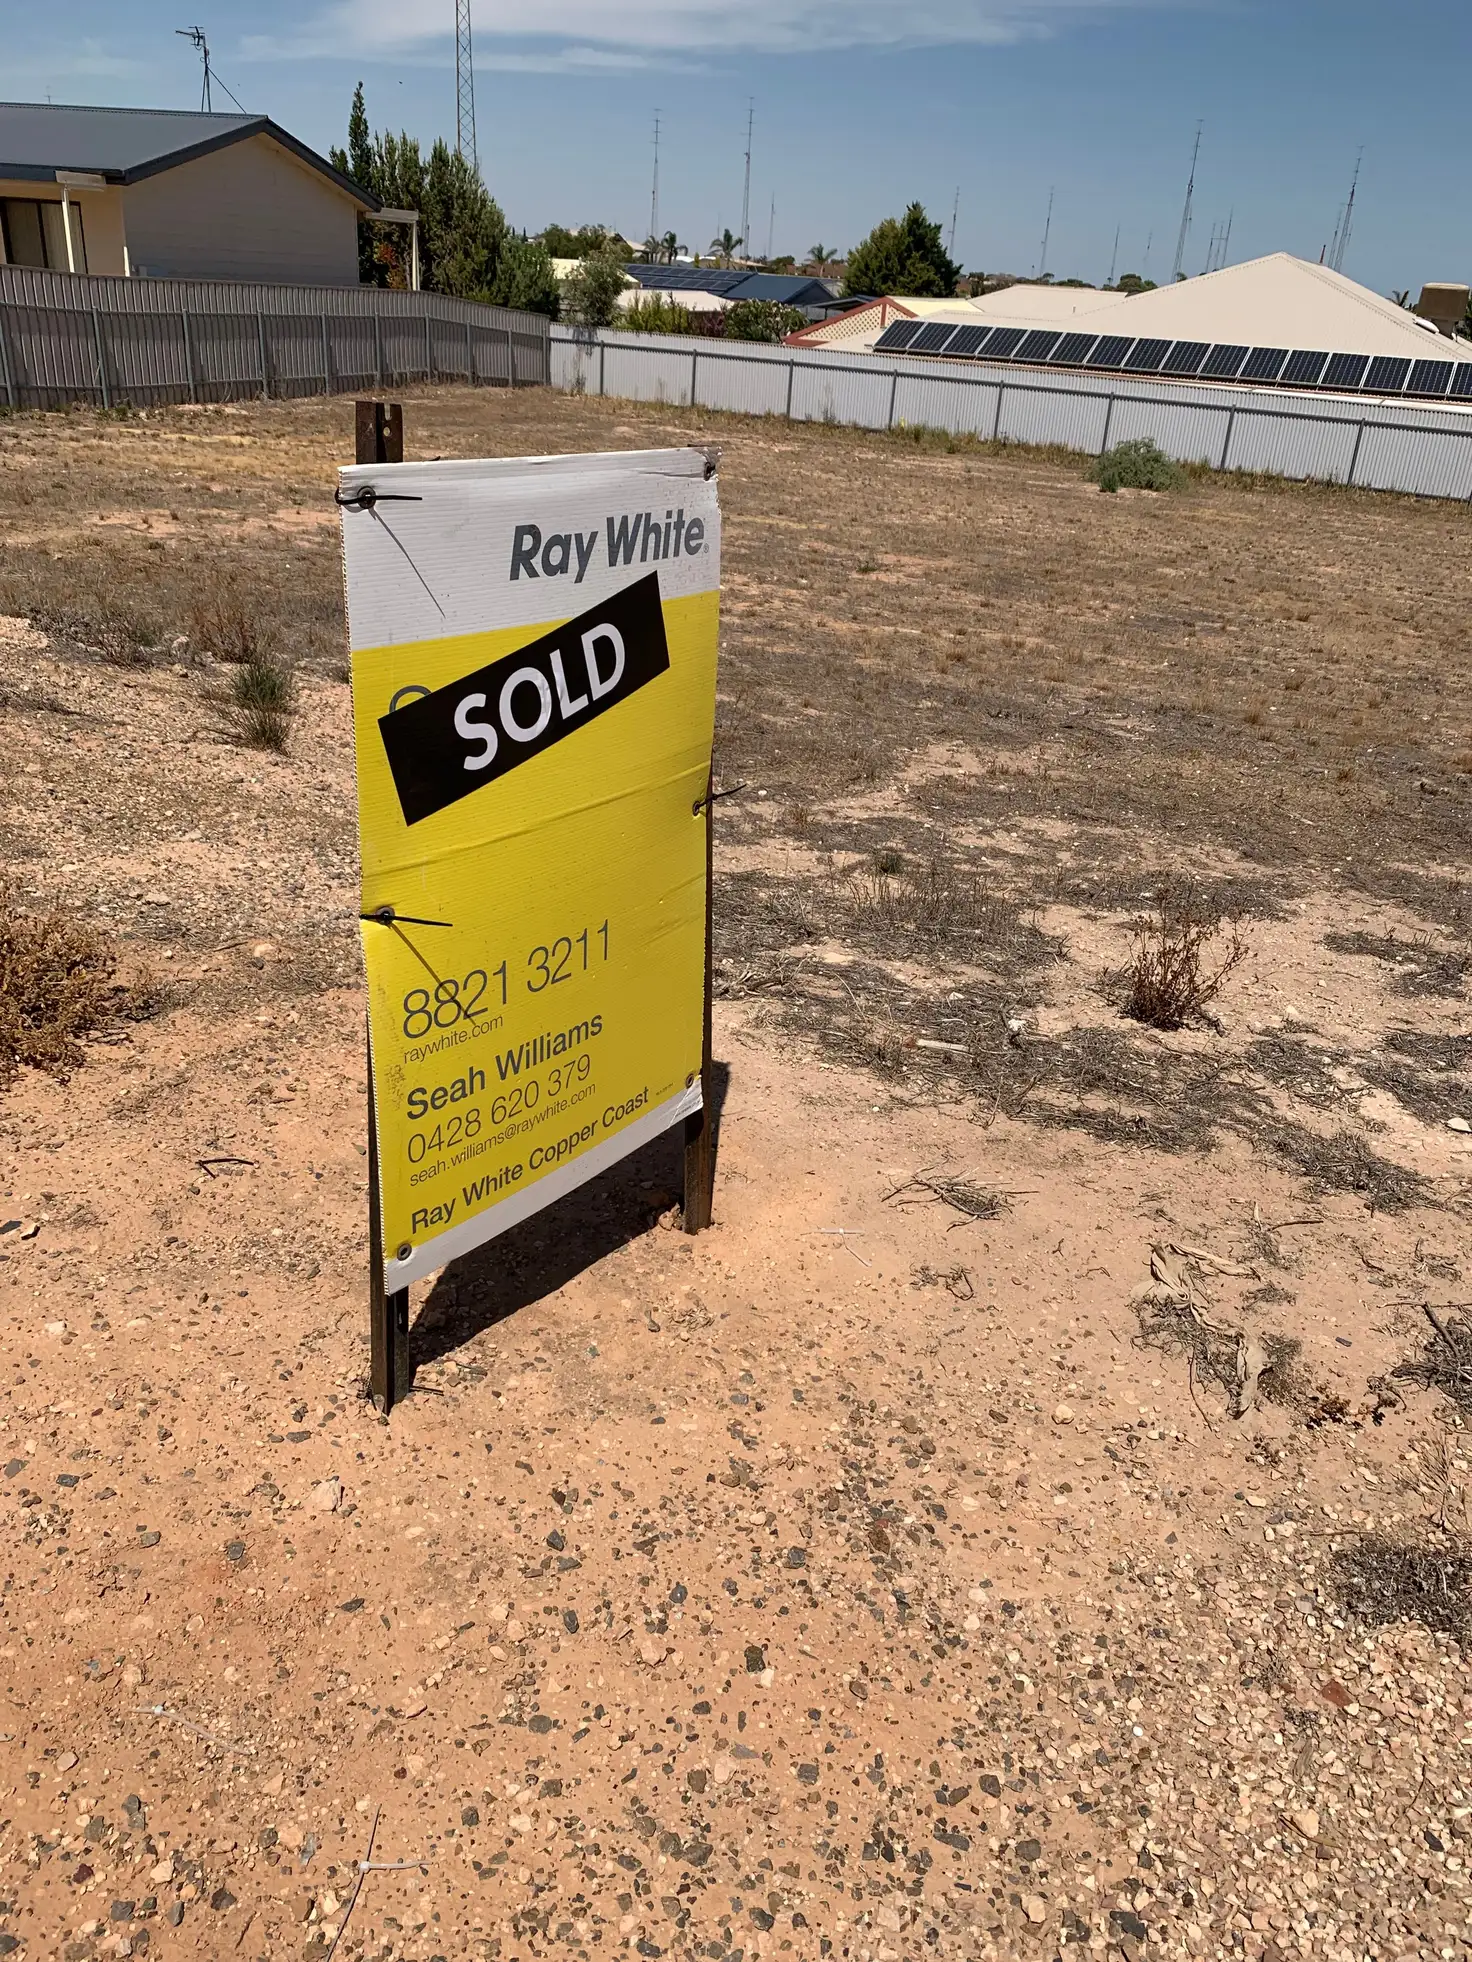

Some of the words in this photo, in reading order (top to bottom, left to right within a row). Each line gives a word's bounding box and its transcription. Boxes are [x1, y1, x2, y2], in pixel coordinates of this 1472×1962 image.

[509, 523, 599, 584] Ray
[606, 508, 705, 568] White
[454, 622, 626, 771] SOLD
[402, 959, 508, 1039] 8821
[526, 919, 610, 994] 3211
[403, 1014, 504, 1064] raywhite.com
[406, 1066, 486, 1121] Seah
[495, 1014, 603, 1081] Williams
[408, 1108, 482, 1163] 0428
[490, 1081, 540, 1125] 620
[547, 1053, 592, 1095] 379
[409, 1082, 596, 1187] seah.williams@raywhite.com
[411, 1198, 456, 1234] Ray
[462, 1163, 524, 1207] White
[528, 1120, 599, 1171] Copper
[602, 1086, 649, 1128] Coast
